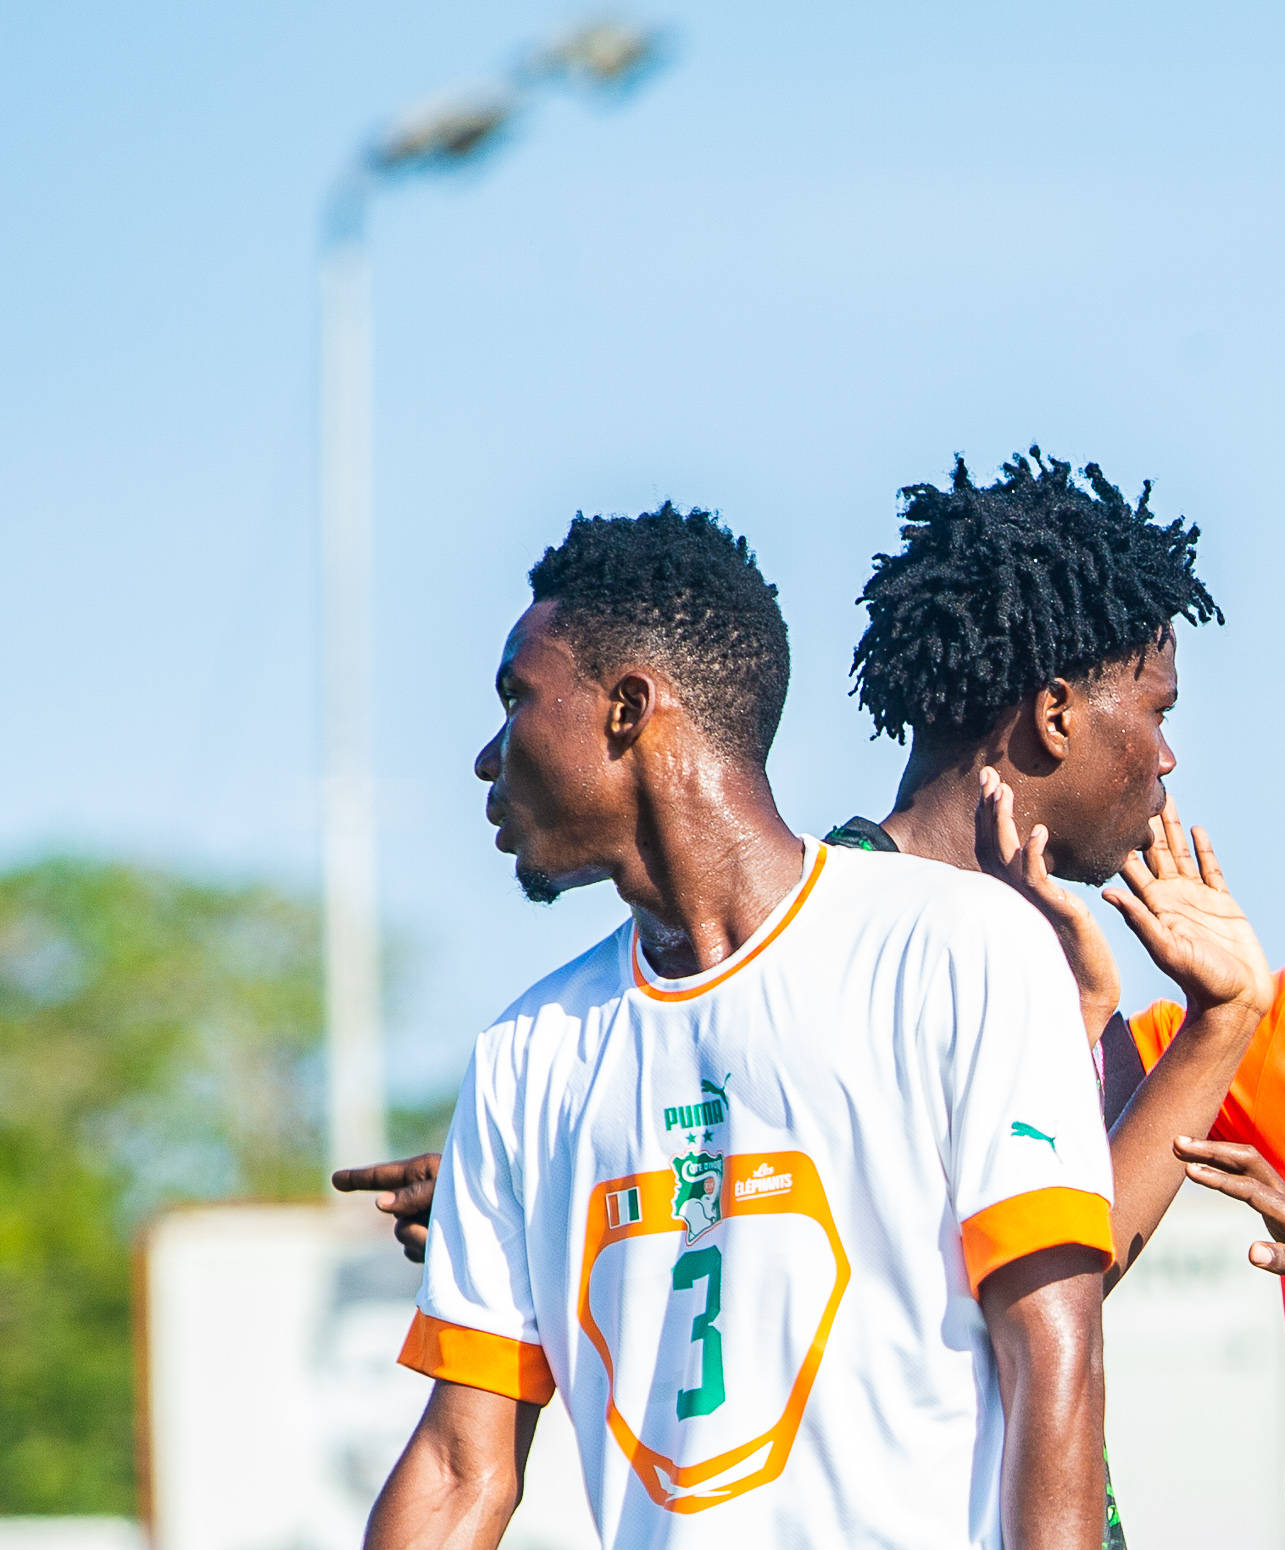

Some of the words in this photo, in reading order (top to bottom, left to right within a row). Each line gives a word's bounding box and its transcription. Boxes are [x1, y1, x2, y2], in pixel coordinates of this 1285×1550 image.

[664, 1100, 724, 1131] PUMA
[735, 1173, 792, 1197] ÉLÉPHANTS
[673, 1245, 726, 1422] 3
